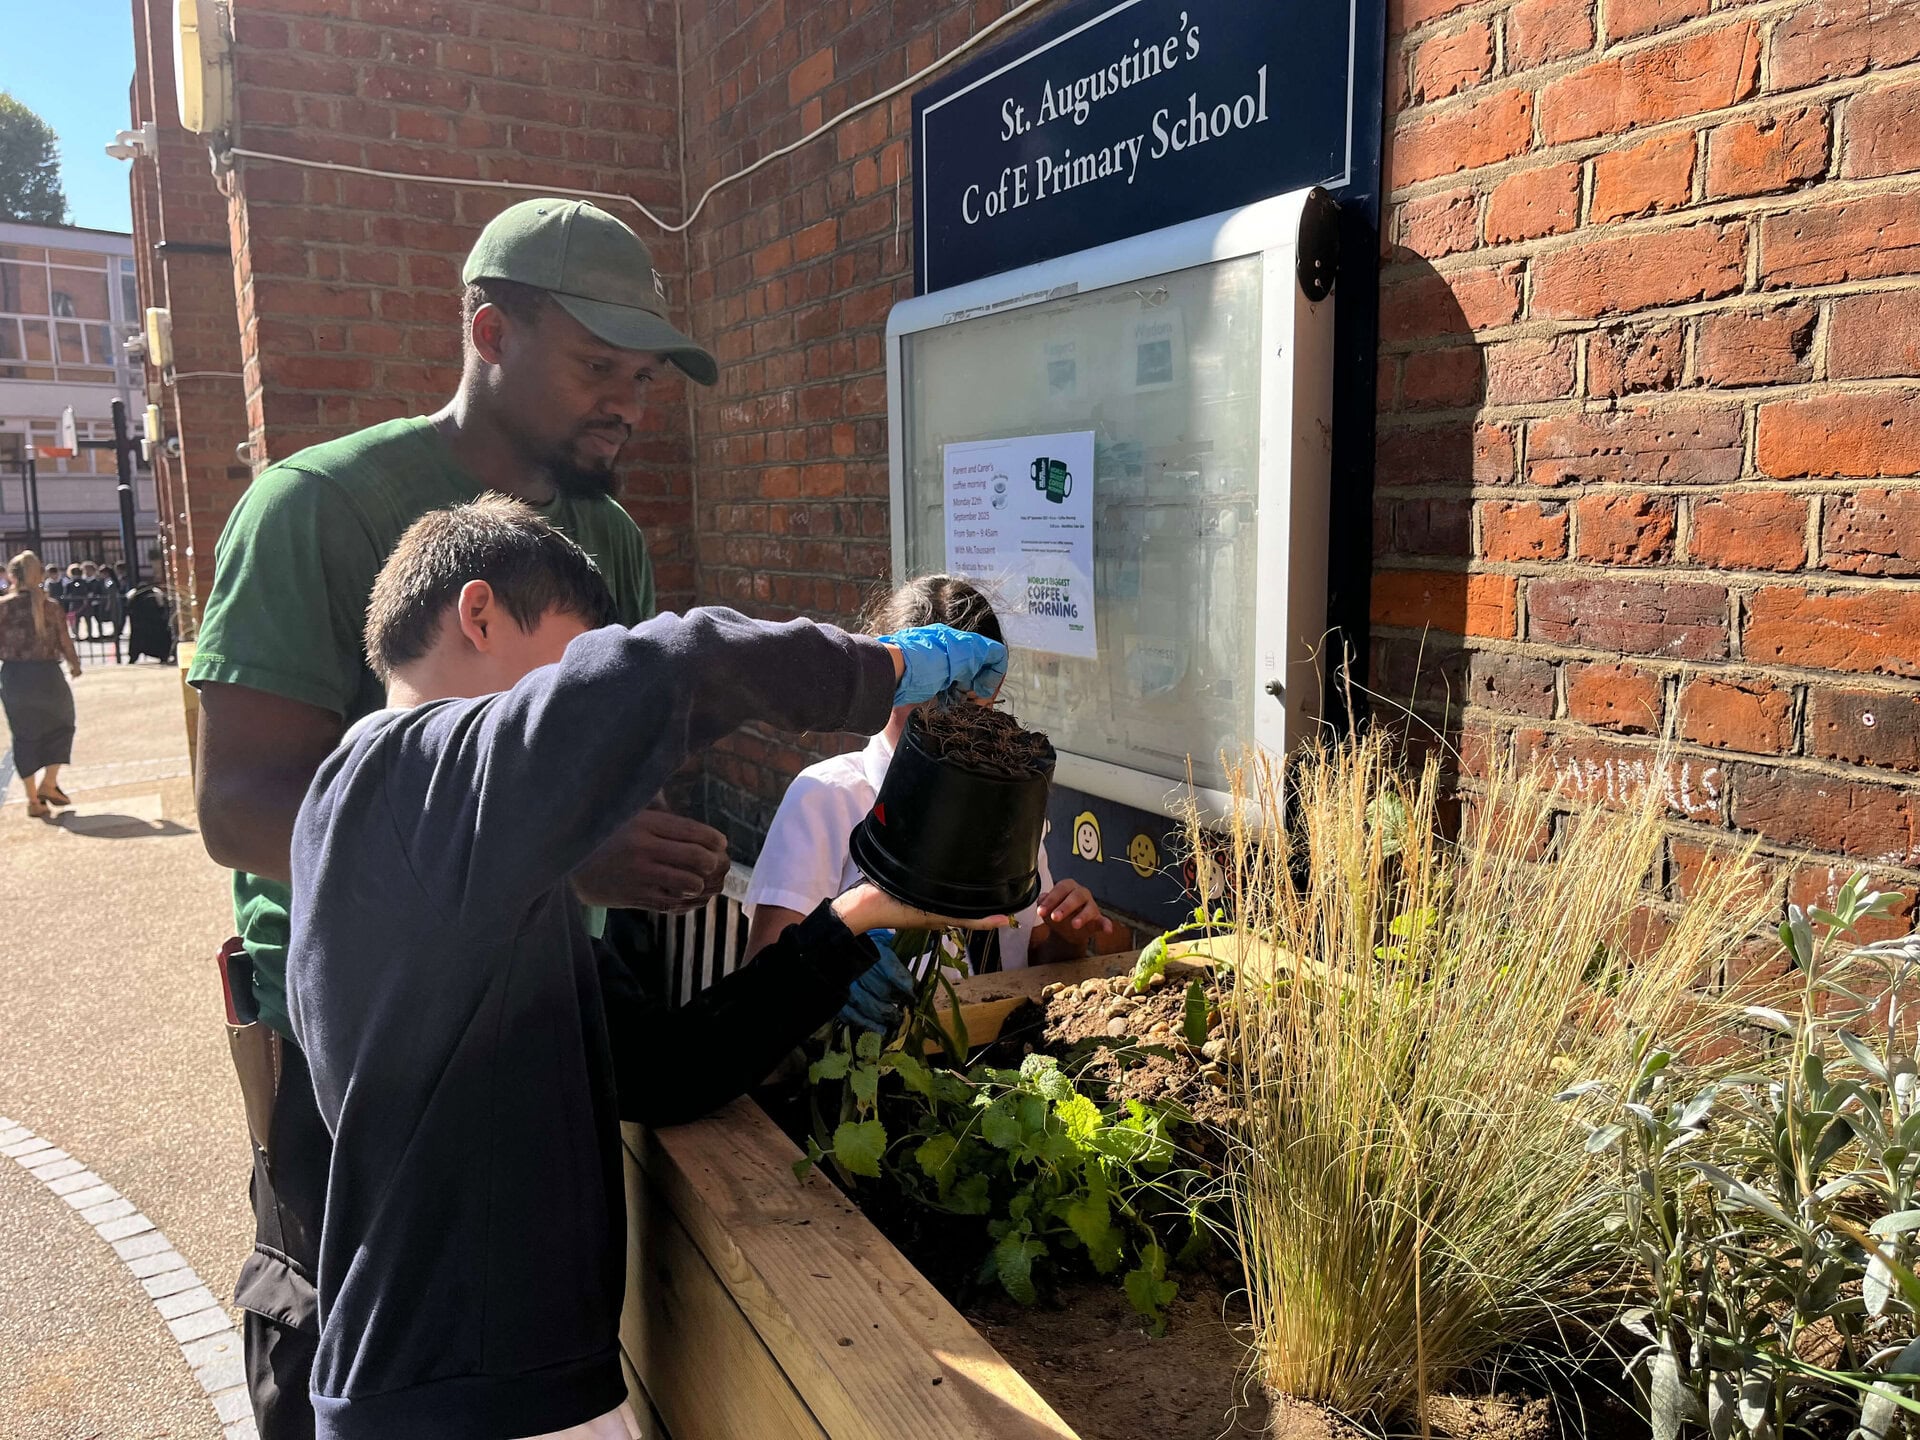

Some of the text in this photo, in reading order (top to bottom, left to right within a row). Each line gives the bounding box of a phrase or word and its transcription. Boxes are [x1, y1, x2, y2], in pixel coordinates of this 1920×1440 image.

[1001, 11, 1201, 142] St. Augustine's
[962, 63, 1269, 225] C of E Primary School
[953, 466, 967, 475] Parent
[968, 465, 976, 473] and
[967, 481, 986, 490] morning
[953, 497, 971, 507] Monday
[953, 512, 990, 523] September 2025
[954, 529, 965, 537] From
[1028, 585, 1061, 602] COFFEE
[1028, 600, 1078, 619] MORNING
